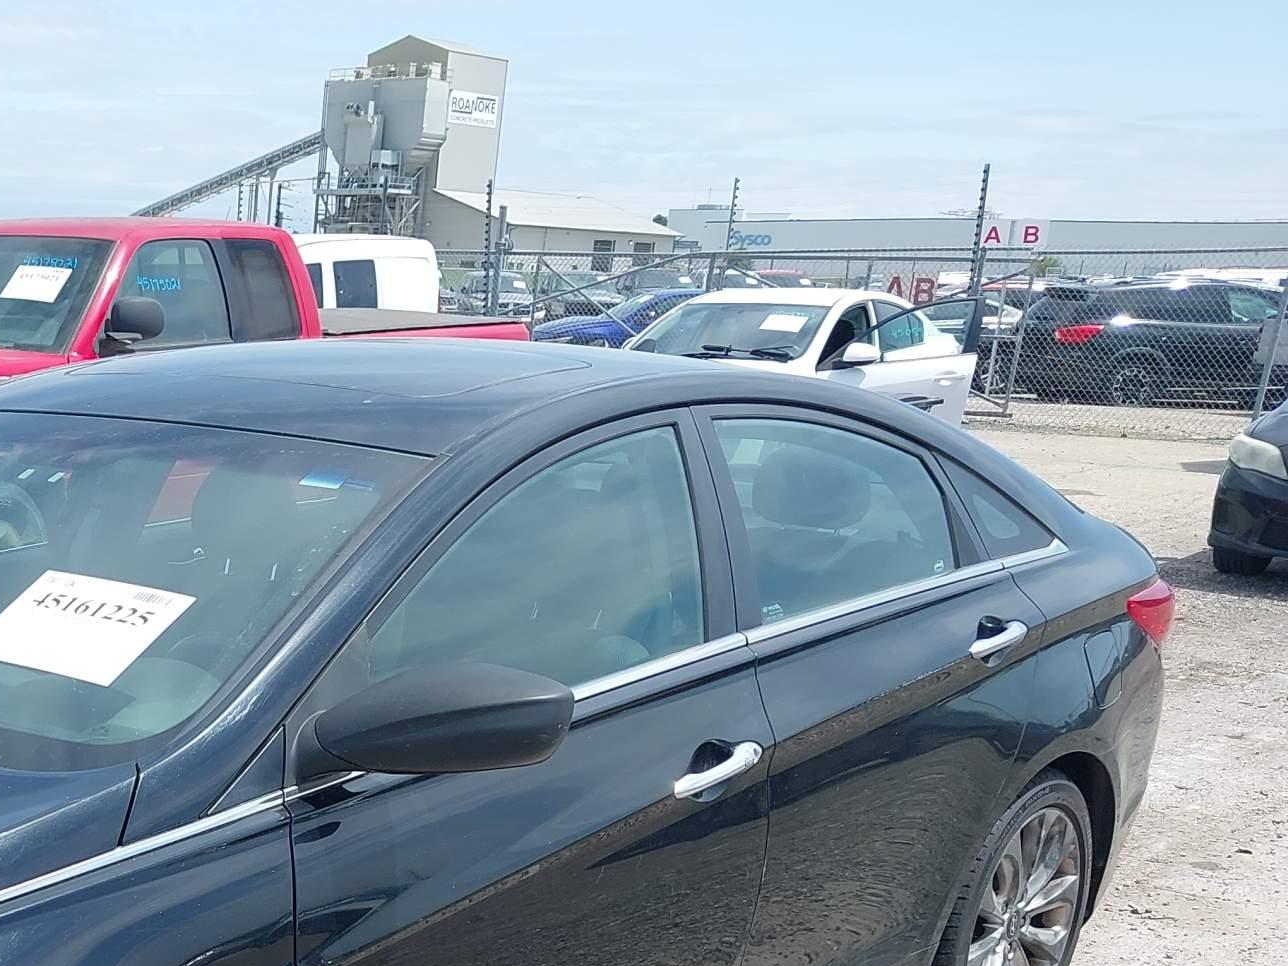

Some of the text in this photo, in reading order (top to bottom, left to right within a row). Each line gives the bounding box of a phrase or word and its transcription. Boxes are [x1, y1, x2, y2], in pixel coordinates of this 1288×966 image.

[452, 96, 497, 115] ROANOKE
[730, 230, 772, 249] Sysco
[983, 226, 1001, 244] A
[1023, 225, 1040, 244] B
[32, 592, 156, 626] 45161225
